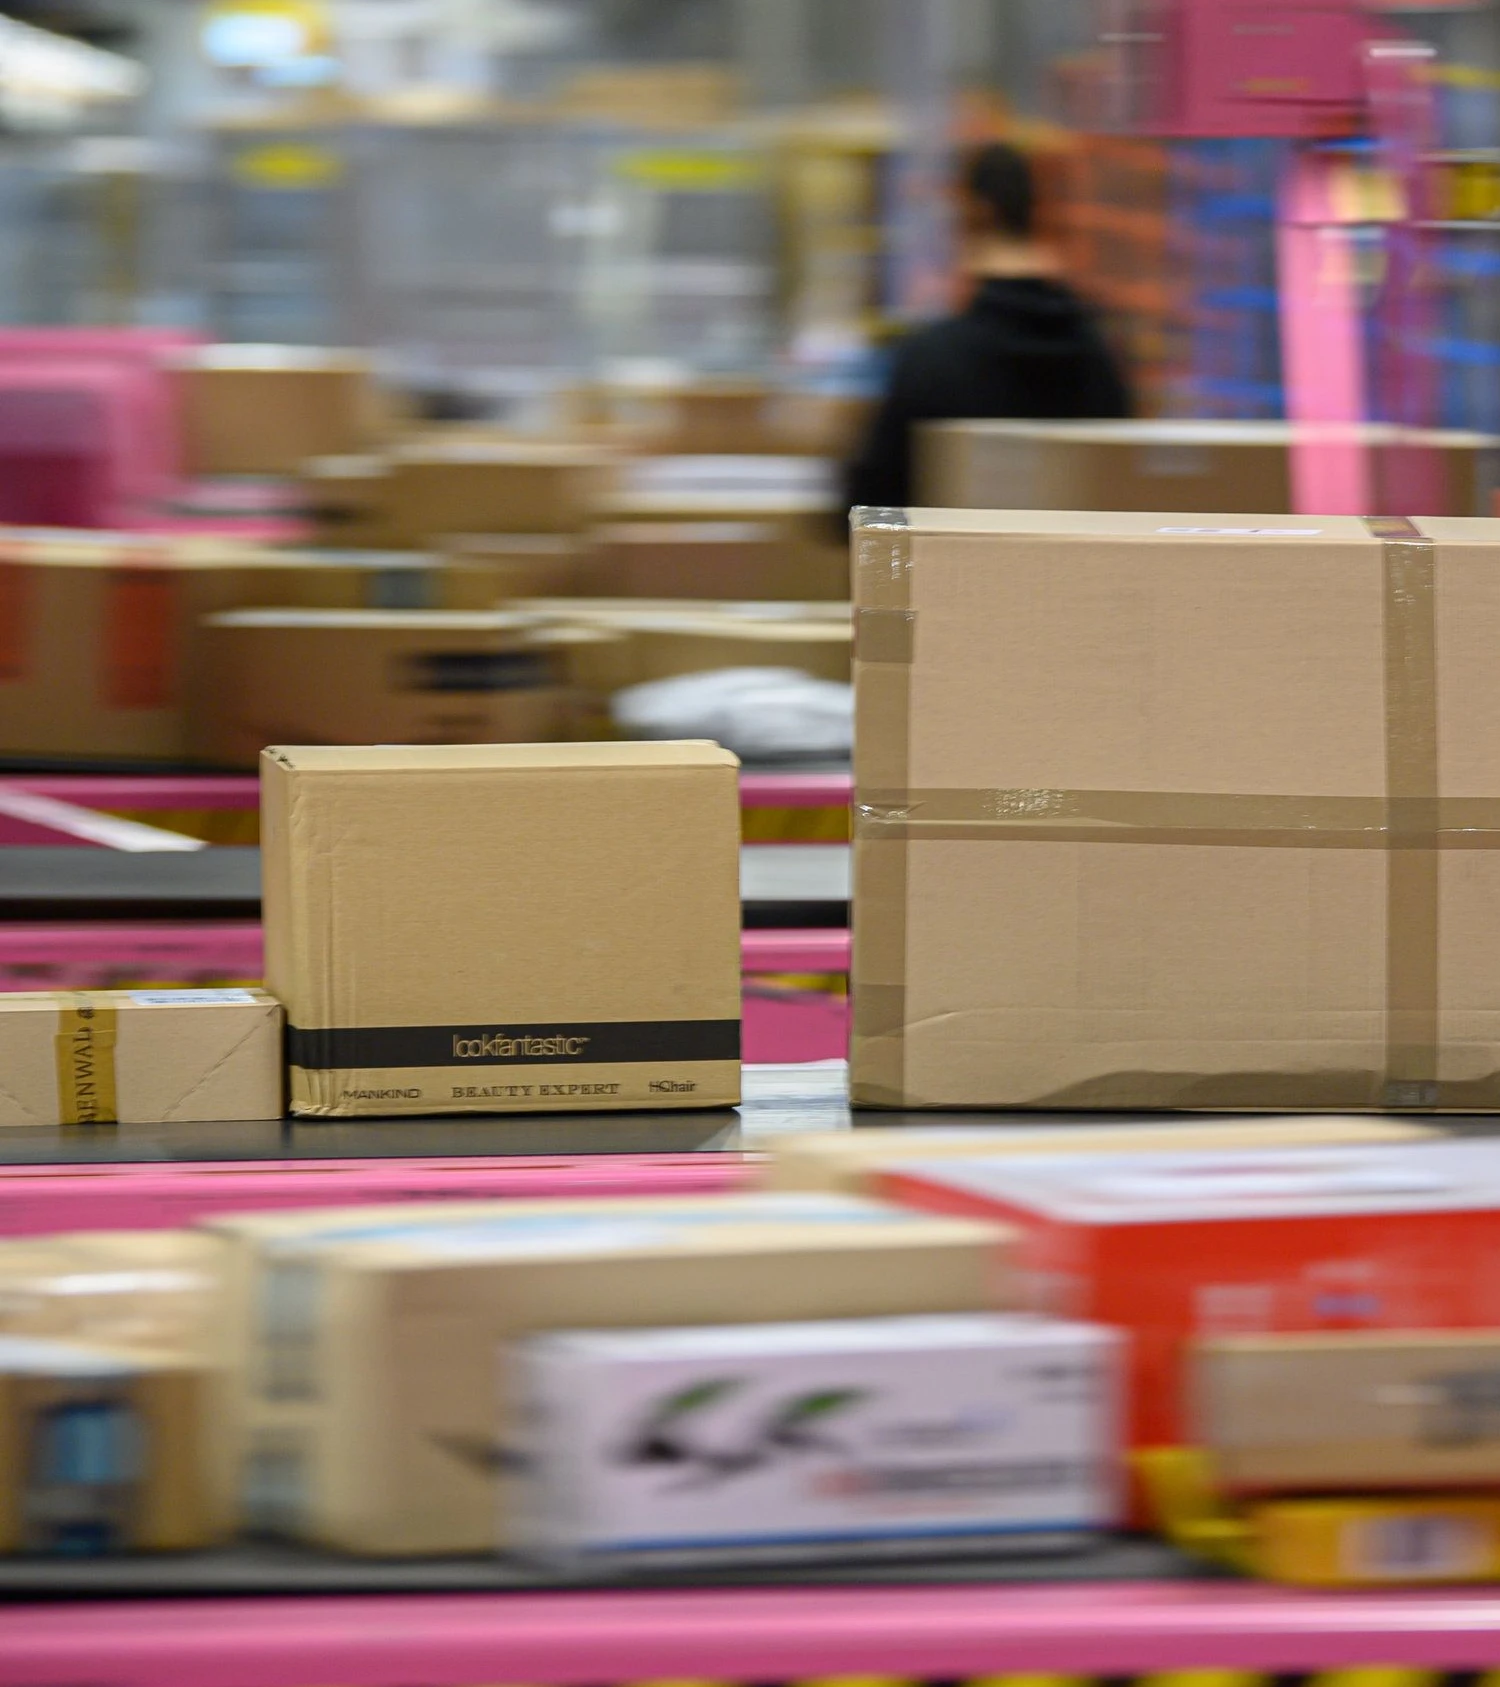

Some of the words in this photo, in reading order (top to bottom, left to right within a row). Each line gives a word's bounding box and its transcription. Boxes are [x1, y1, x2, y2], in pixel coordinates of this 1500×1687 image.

[342, 1088, 422, 1100] MANKIND
[451, 1085, 534, 1098] BEAUTY
[539, 1083, 622, 1096] EXPERT
